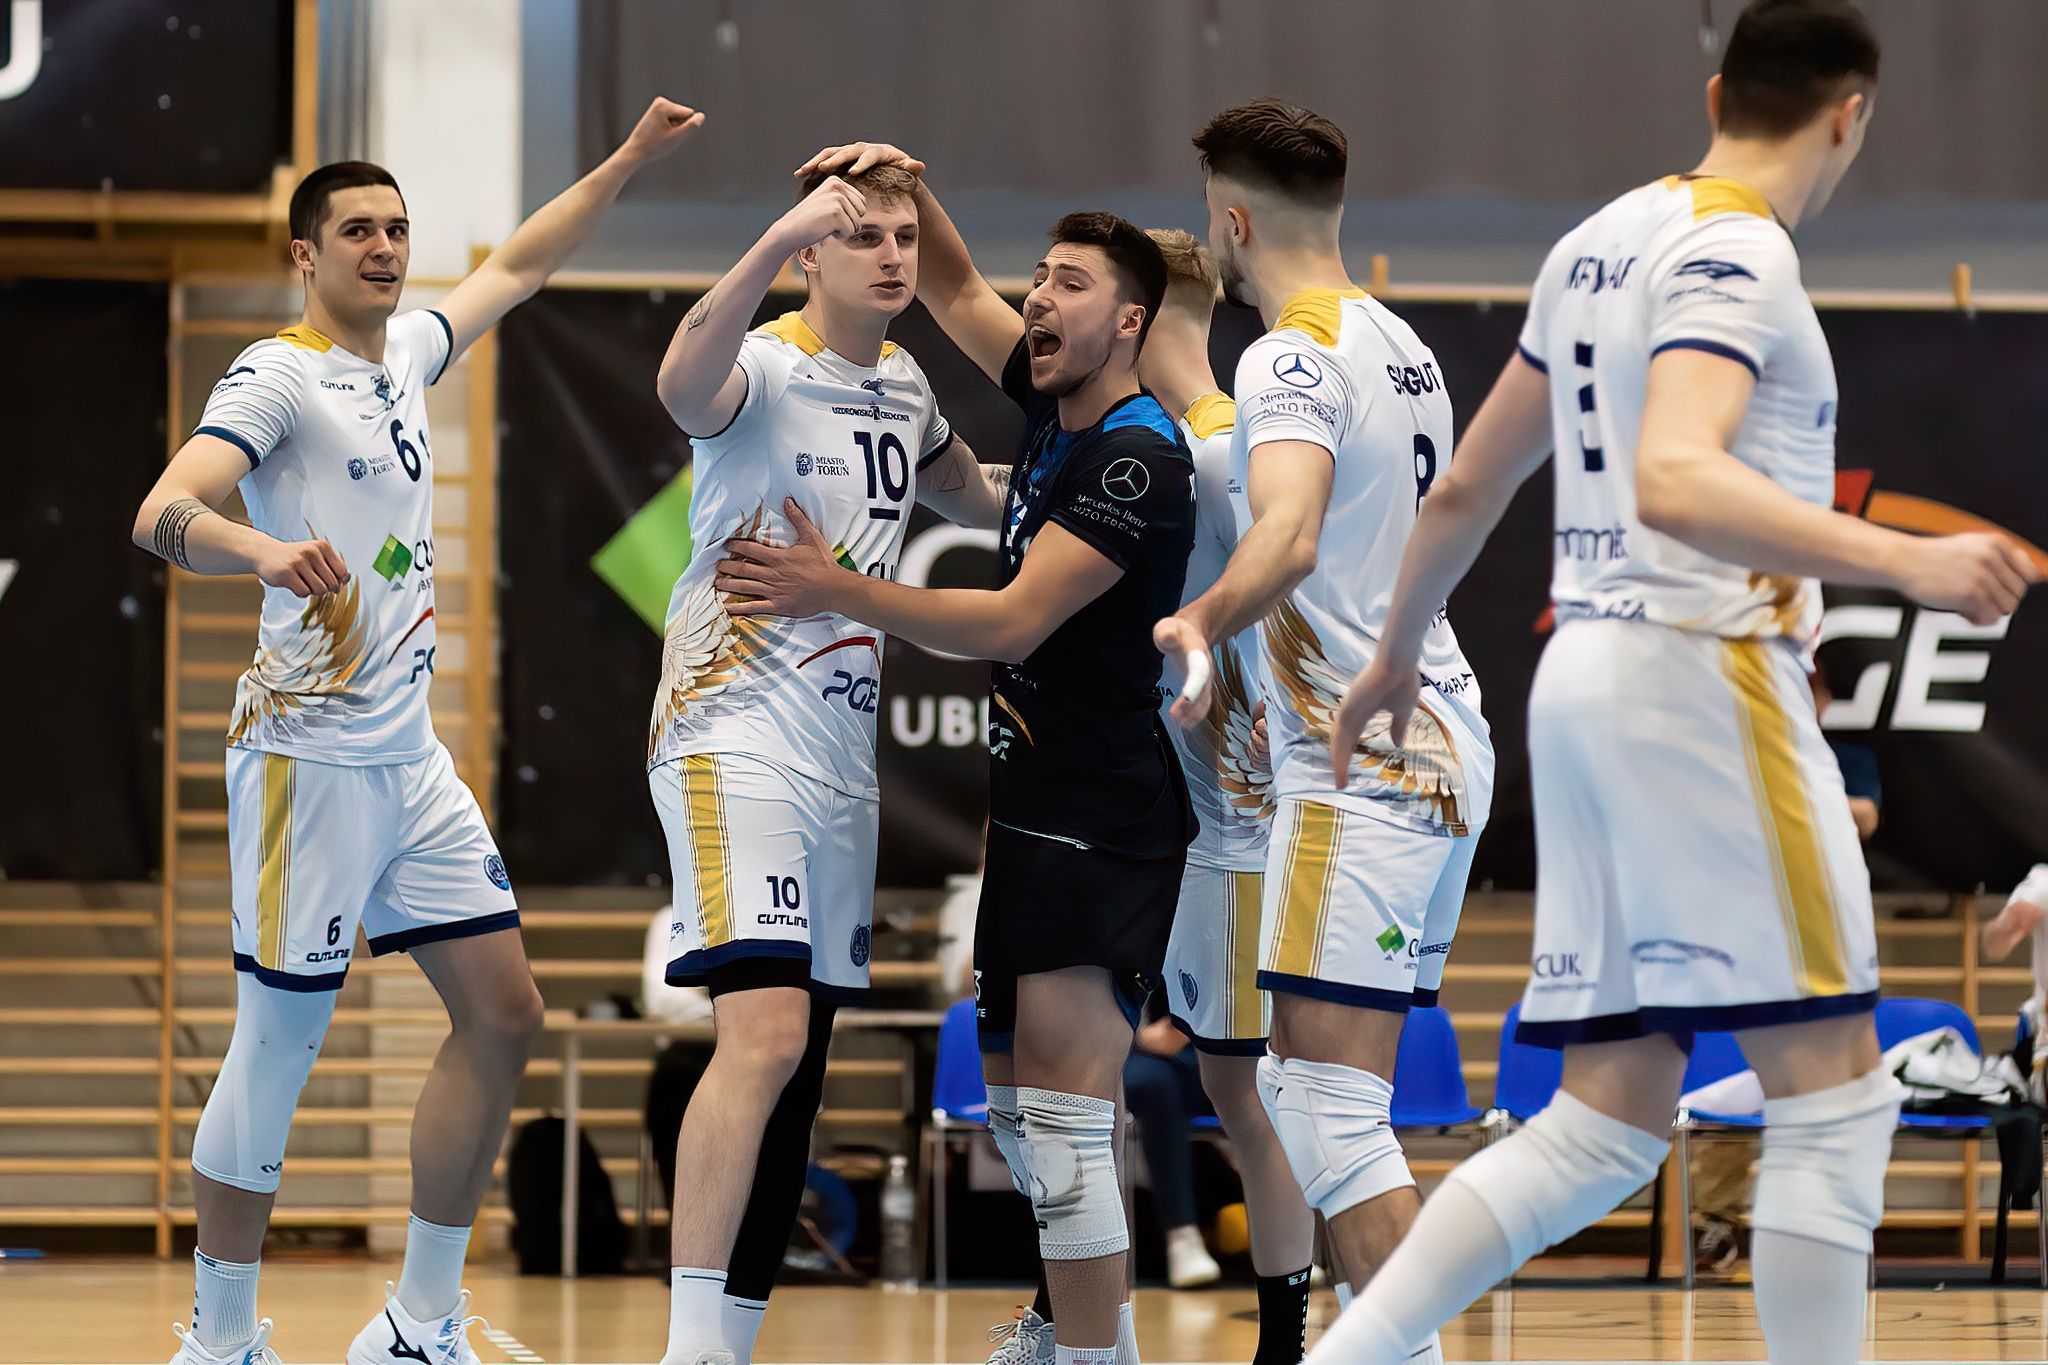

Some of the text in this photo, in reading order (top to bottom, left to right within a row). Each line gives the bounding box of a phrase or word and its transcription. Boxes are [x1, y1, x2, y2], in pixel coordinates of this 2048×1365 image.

[390, 419, 422, 482] 6
[815, 457, 845, 466] MIASTO
[853, 431, 909, 503] 10
[766, 875, 801, 910] 10
[327, 915, 342, 946] 6
[756, 914, 808, 929] CUTLINE
[1534, 952, 1582, 978] CUK
